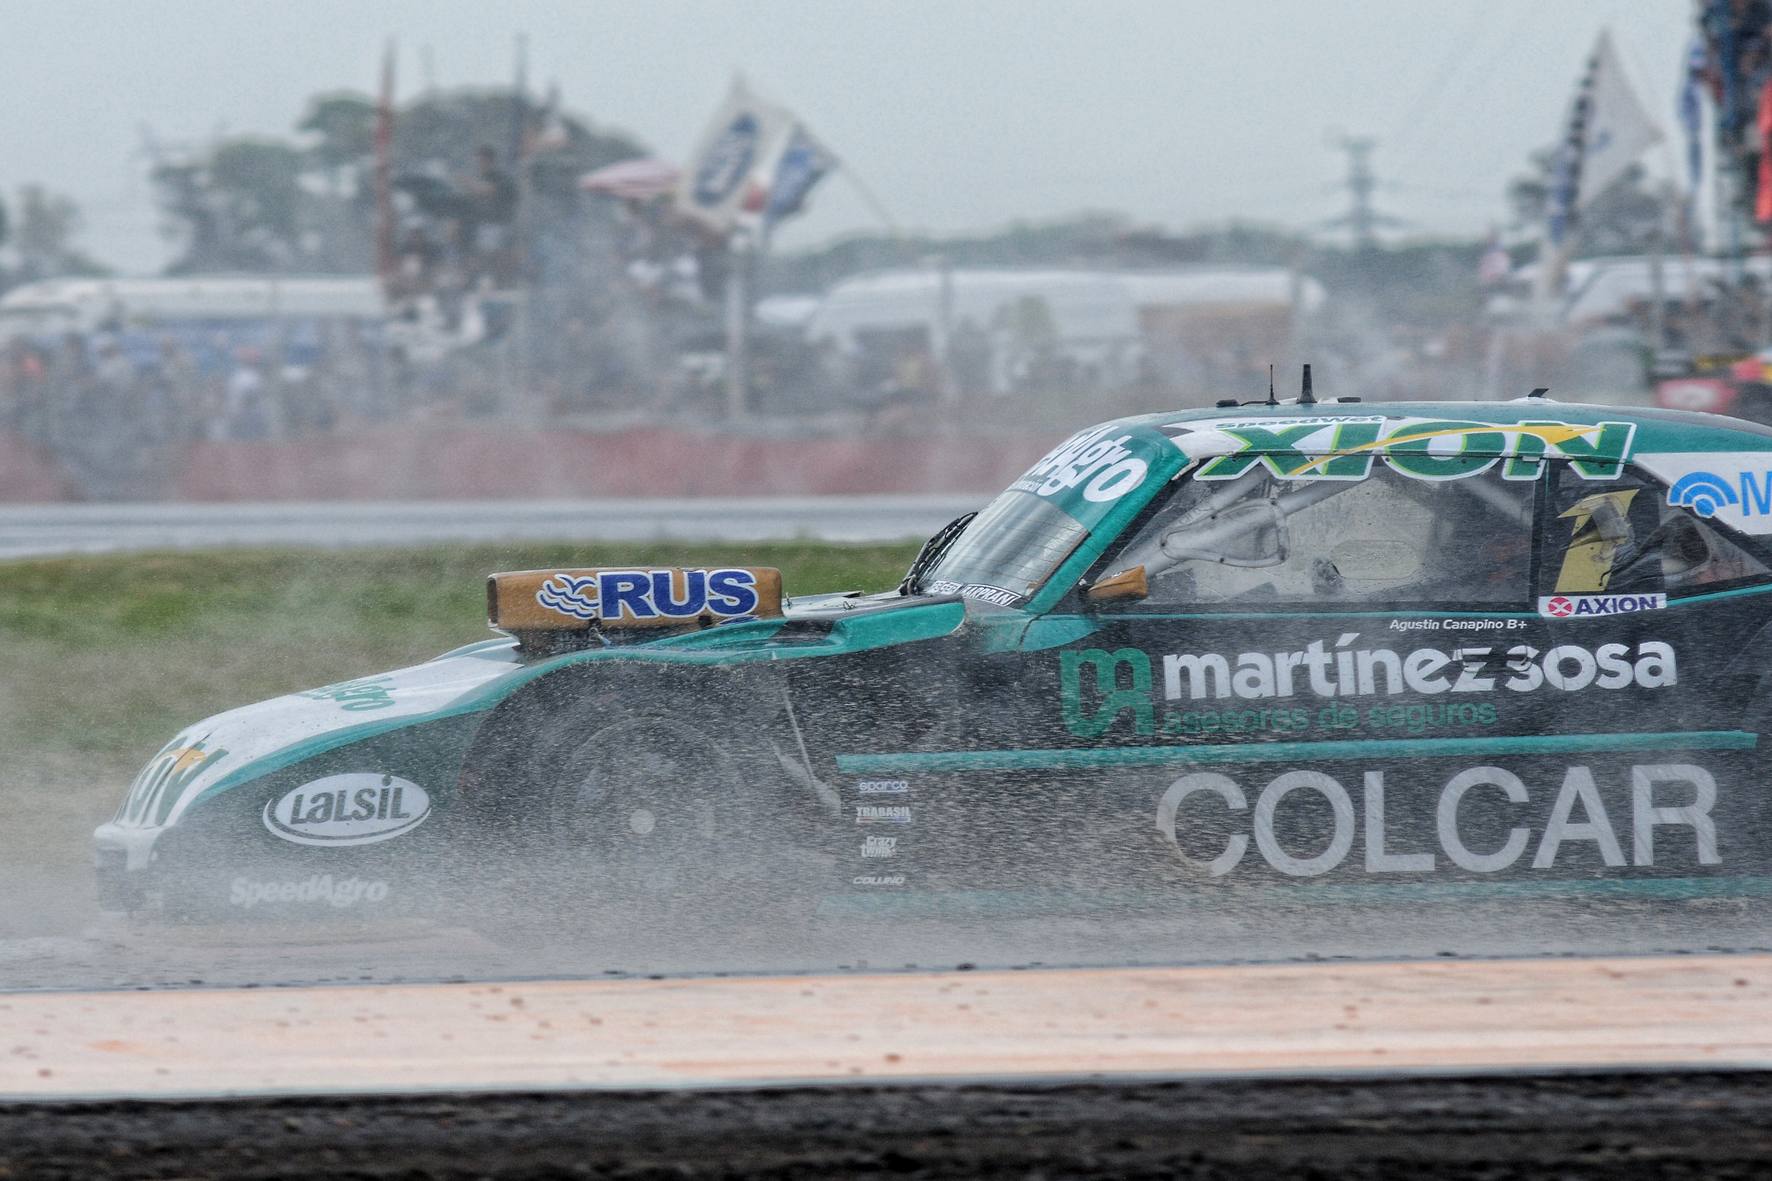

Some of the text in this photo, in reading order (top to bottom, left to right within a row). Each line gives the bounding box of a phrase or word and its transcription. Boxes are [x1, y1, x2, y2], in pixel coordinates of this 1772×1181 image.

[600, 569, 760, 617] RUS
[1574, 596, 1658, 616] AXION
[1443, 620, 1504, 632] Canapino
[1506, 619, 1527, 629] B+
[1163, 632, 1678, 700] martínez sosa
[1317, 700, 1360, 729] de
[1367, 702, 1497, 733] seguros
[1156, 764, 1723, 878] COLCAR
[229, 874, 389, 909] SpeedAgro
